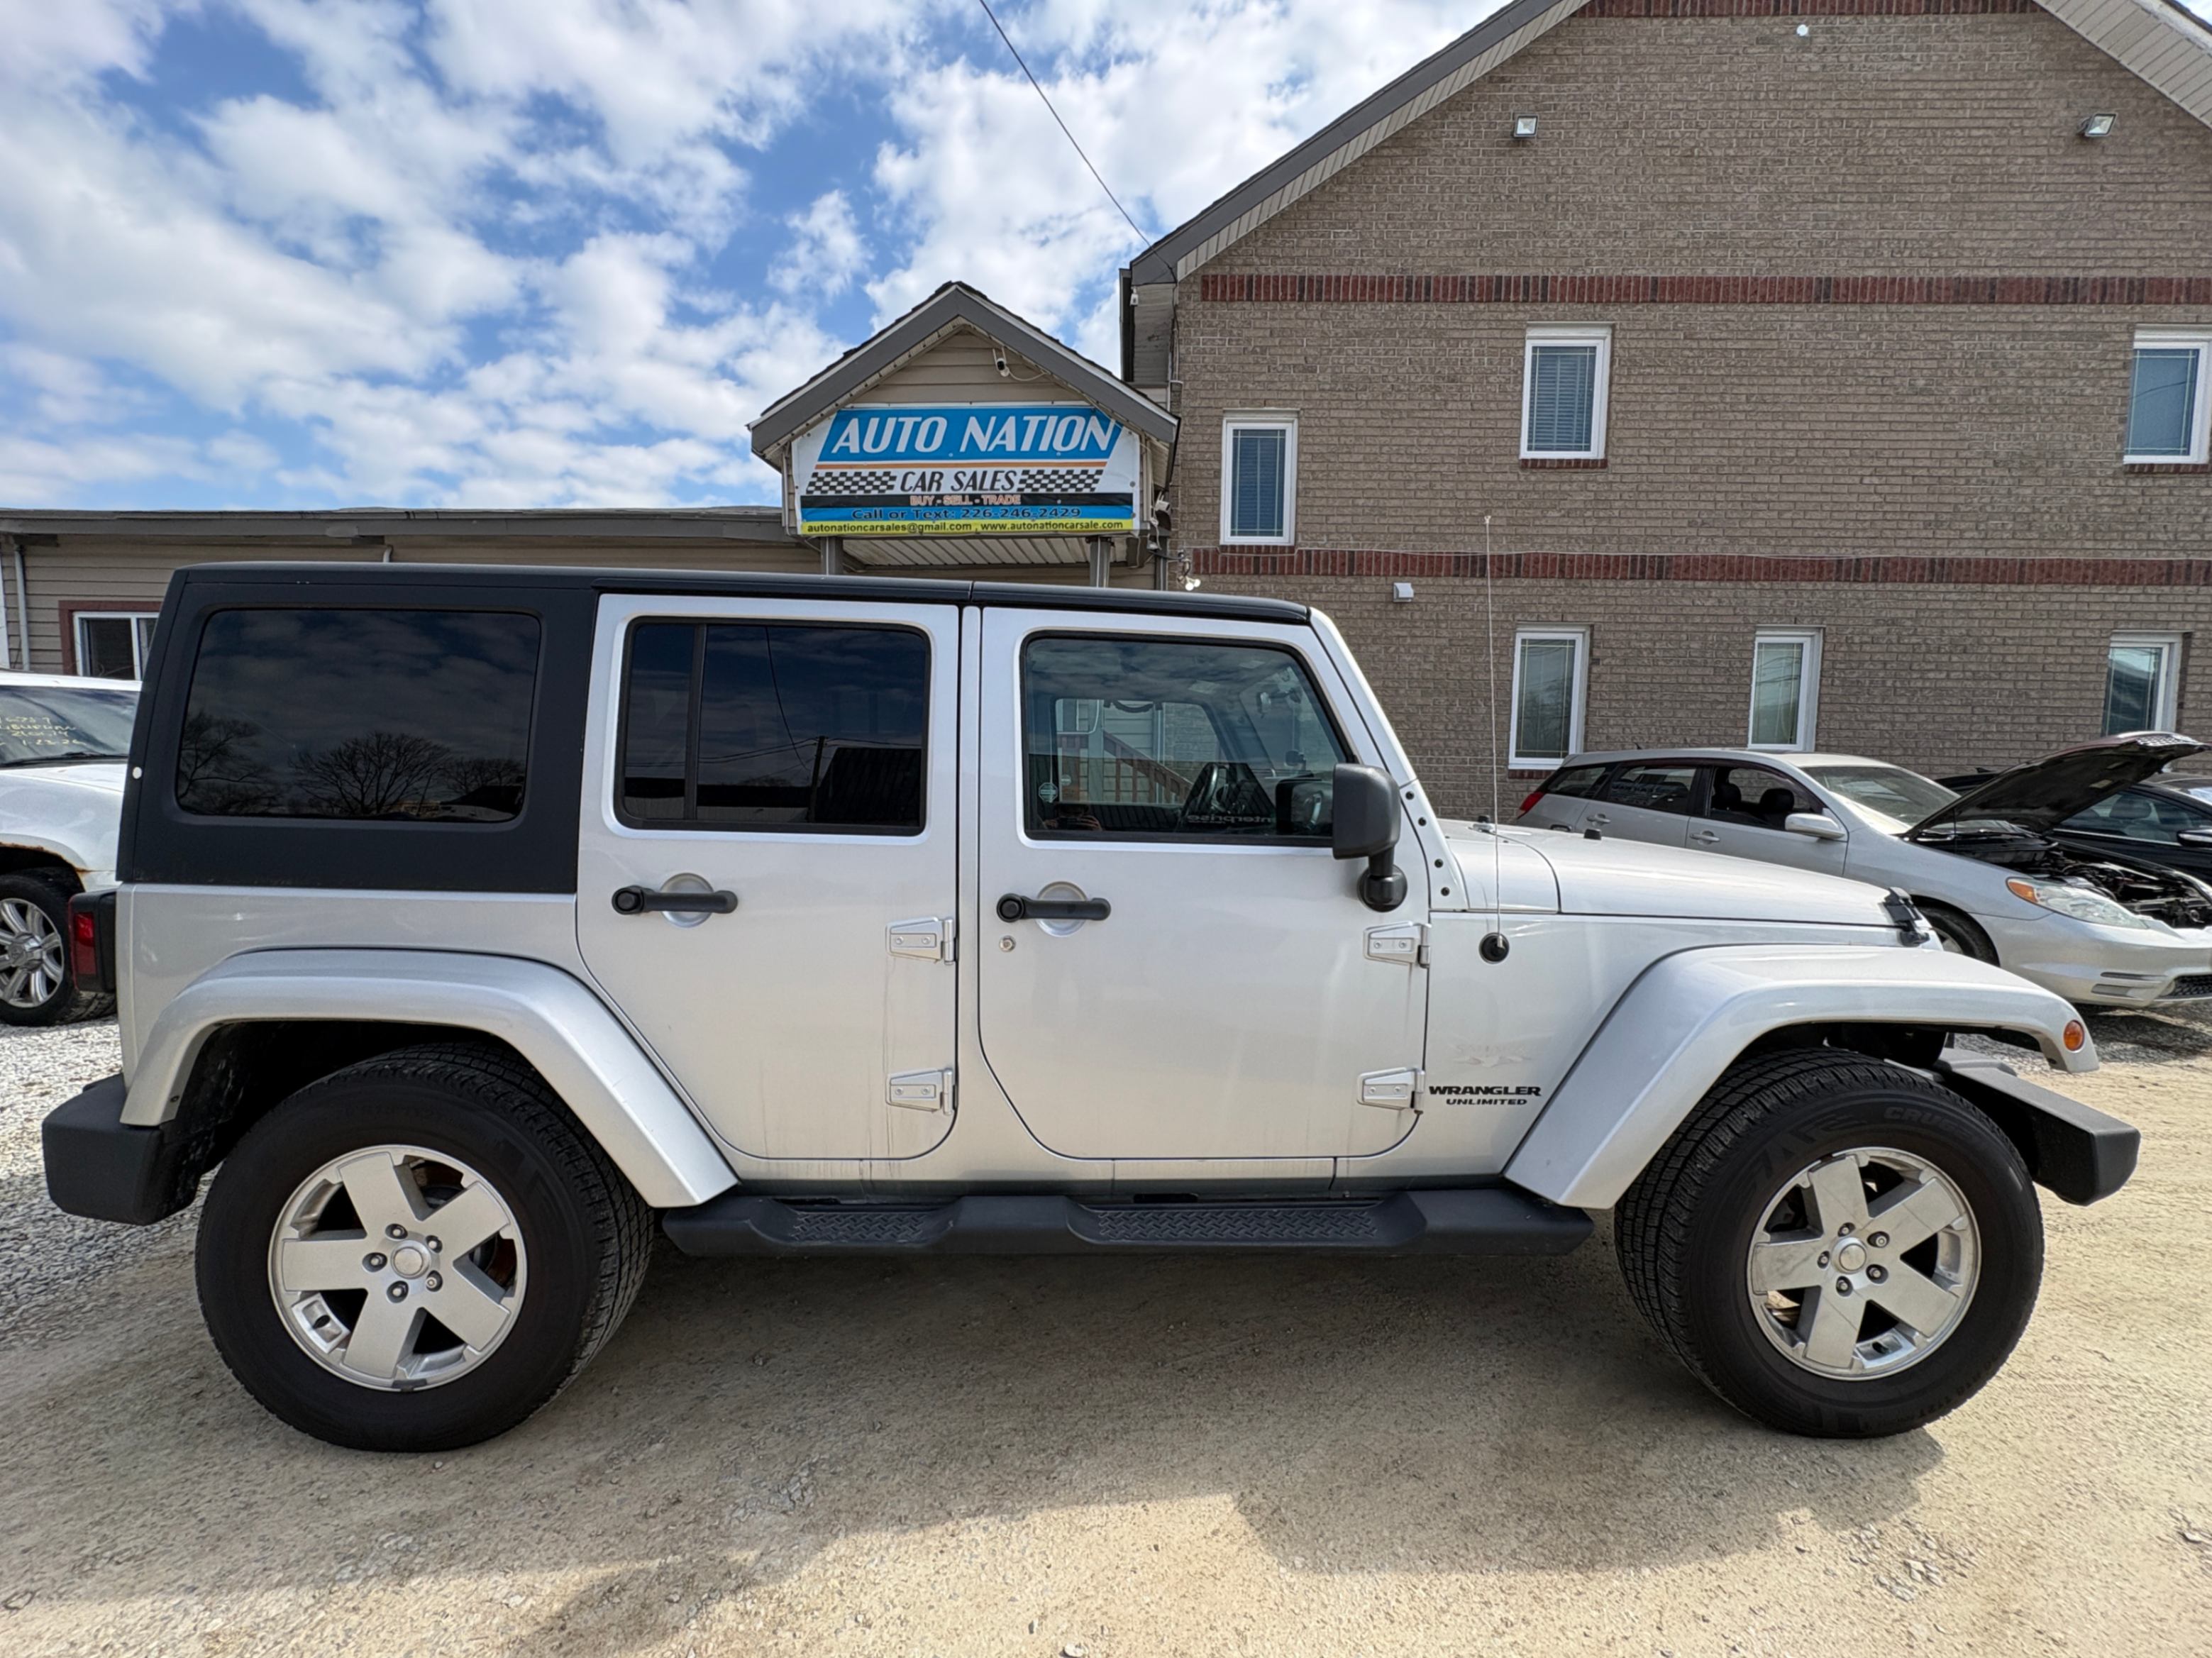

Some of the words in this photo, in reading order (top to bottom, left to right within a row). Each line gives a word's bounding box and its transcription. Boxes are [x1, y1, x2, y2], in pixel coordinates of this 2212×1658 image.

[831, 416, 947, 453] AUTO
[959, 415, 1116, 453] NATION
[900, 470, 944, 492] CAR
[951, 470, 1017, 492] SALES
[910, 496, 935, 506] BUY
[943, 495, 973, 506] SELL
[981, 494, 1022, 505] TRADE
[852, 509, 883, 519] Call
[889, 511, 907, 519] or
[913, 509, 956, 519] Text:
[961, 508, 1081, 518] 226-246-2429
[807, 522, 972, 533] autonationcarsales@gmail.com
[980, 520, 1124, 531] www.autonationcarsale.com
[1429, 1085, 1542, 1097] WRANGLER
